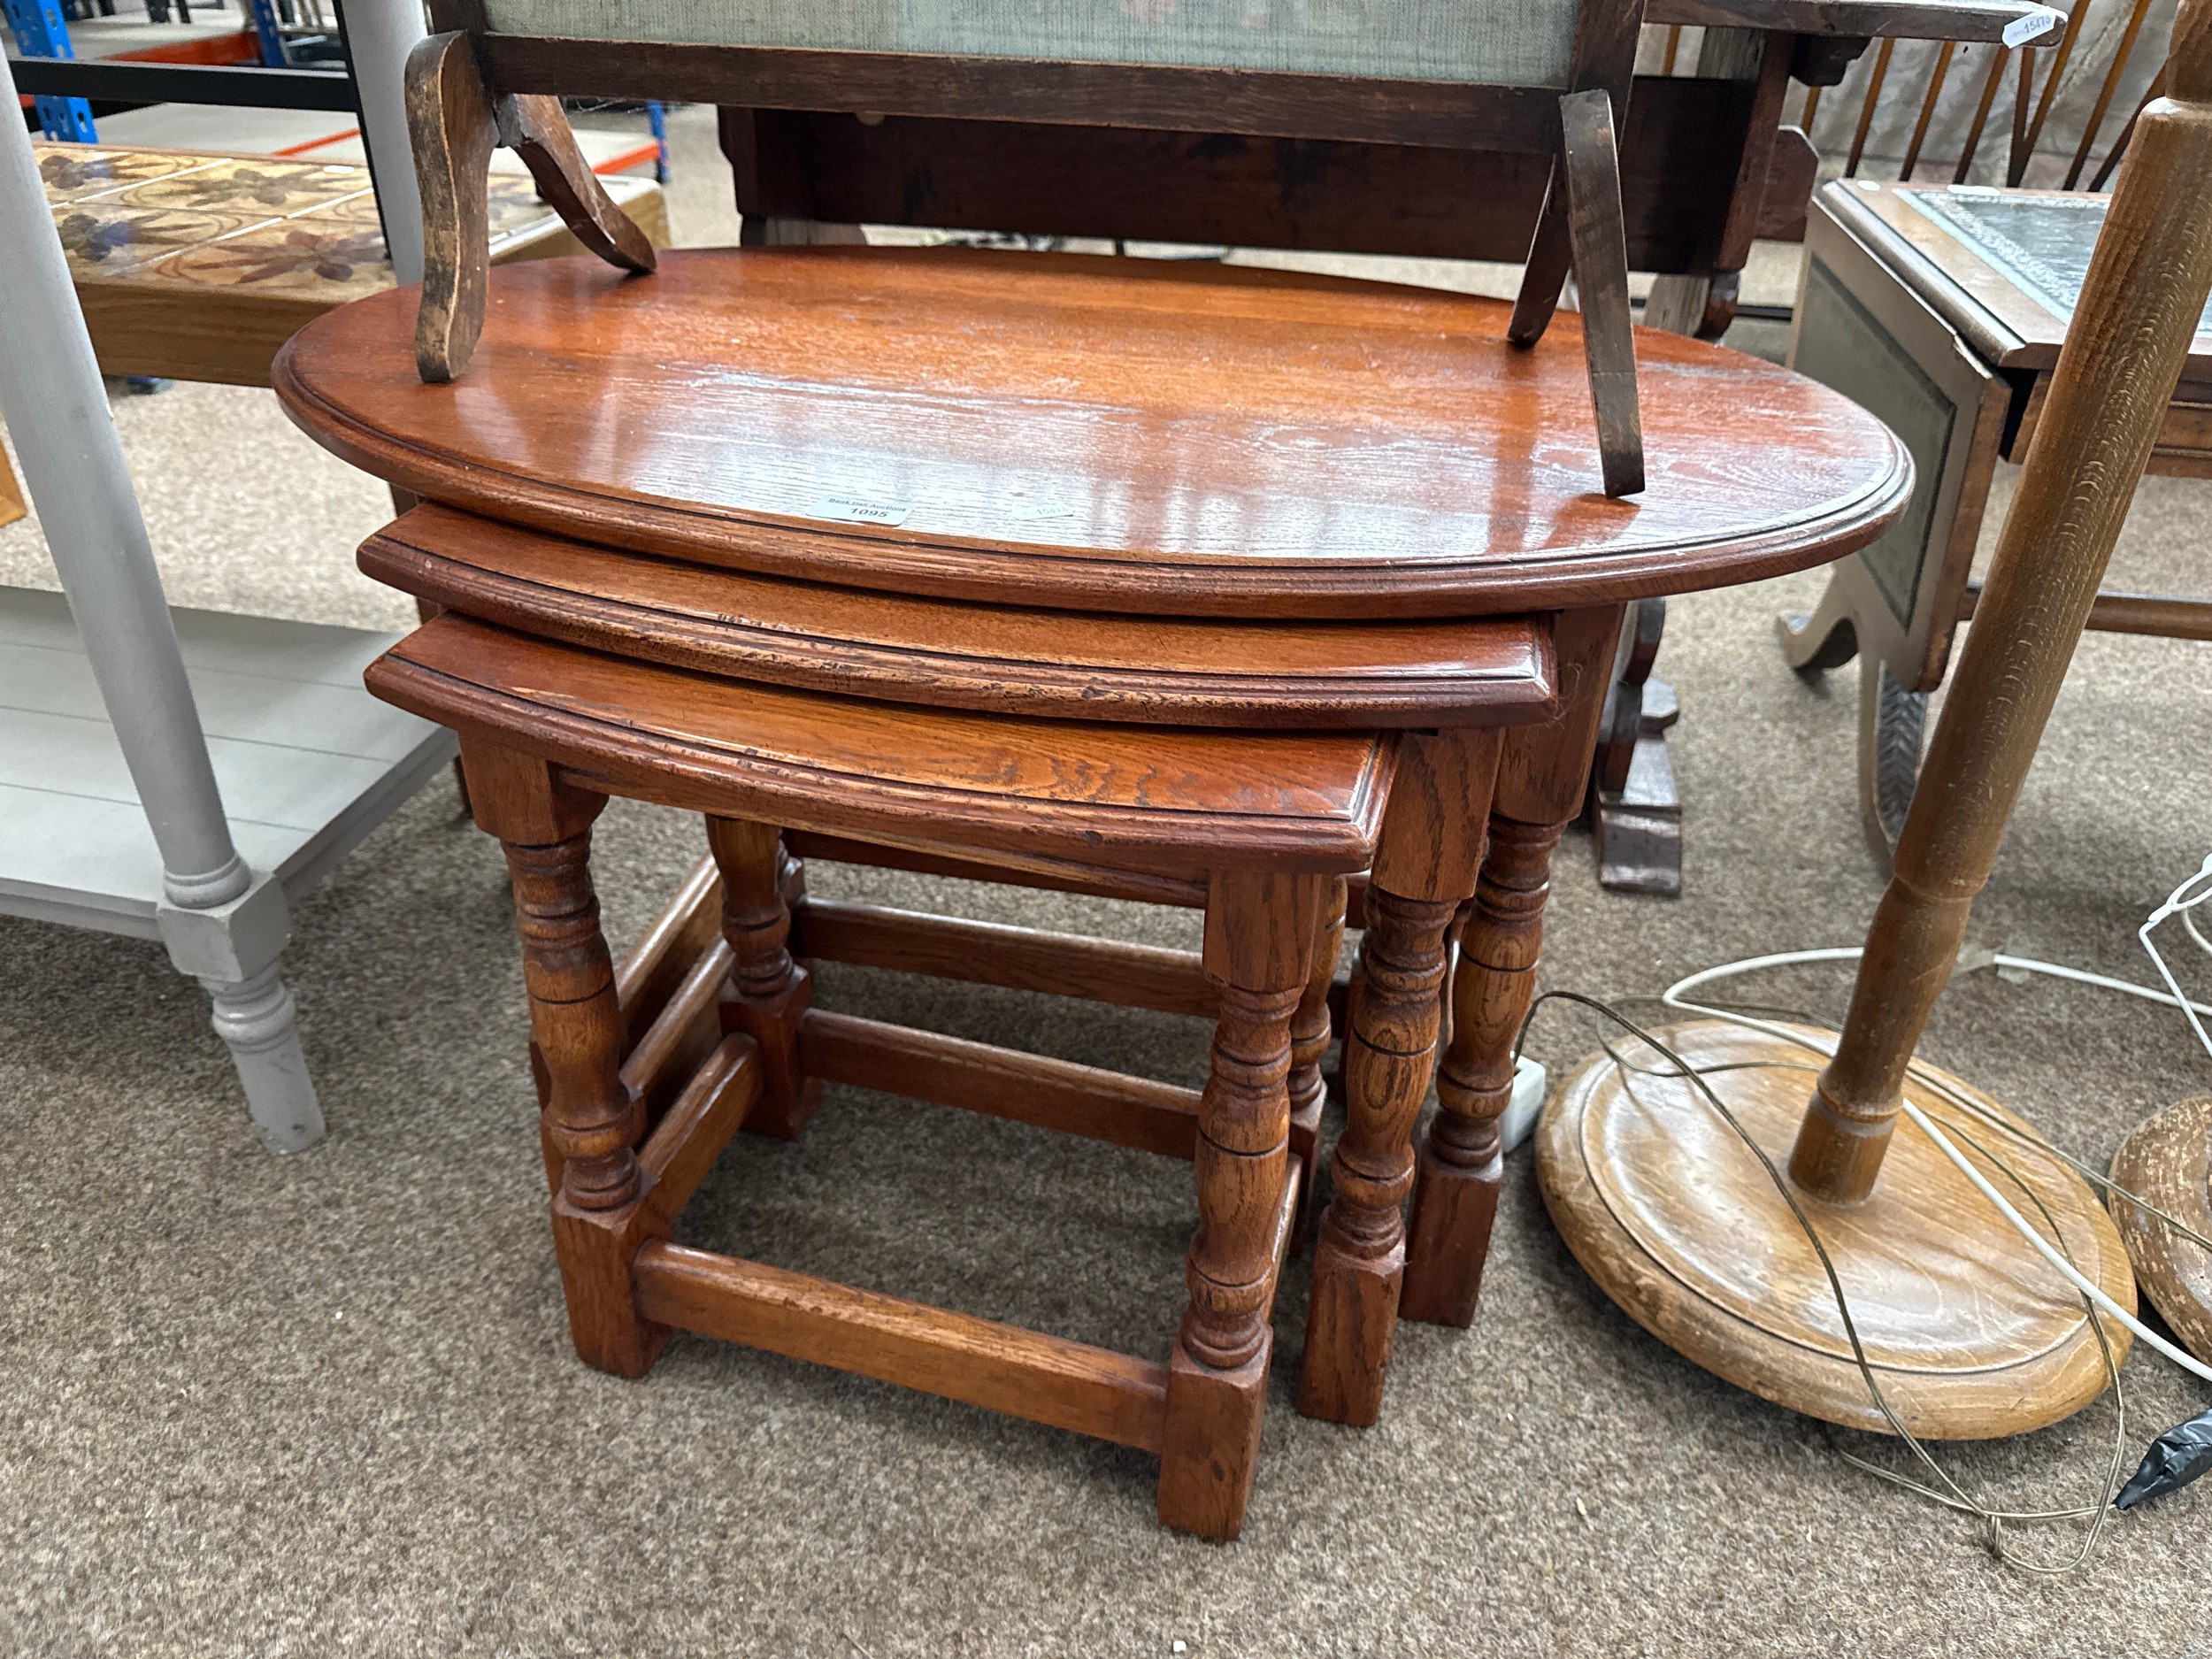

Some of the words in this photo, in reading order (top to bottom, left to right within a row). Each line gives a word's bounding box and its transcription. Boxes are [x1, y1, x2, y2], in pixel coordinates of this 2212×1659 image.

[828, 497, 850, 506] Bank
[869, 503, 907, 512] Auctions
[850, 508, 889, 518] 1095
